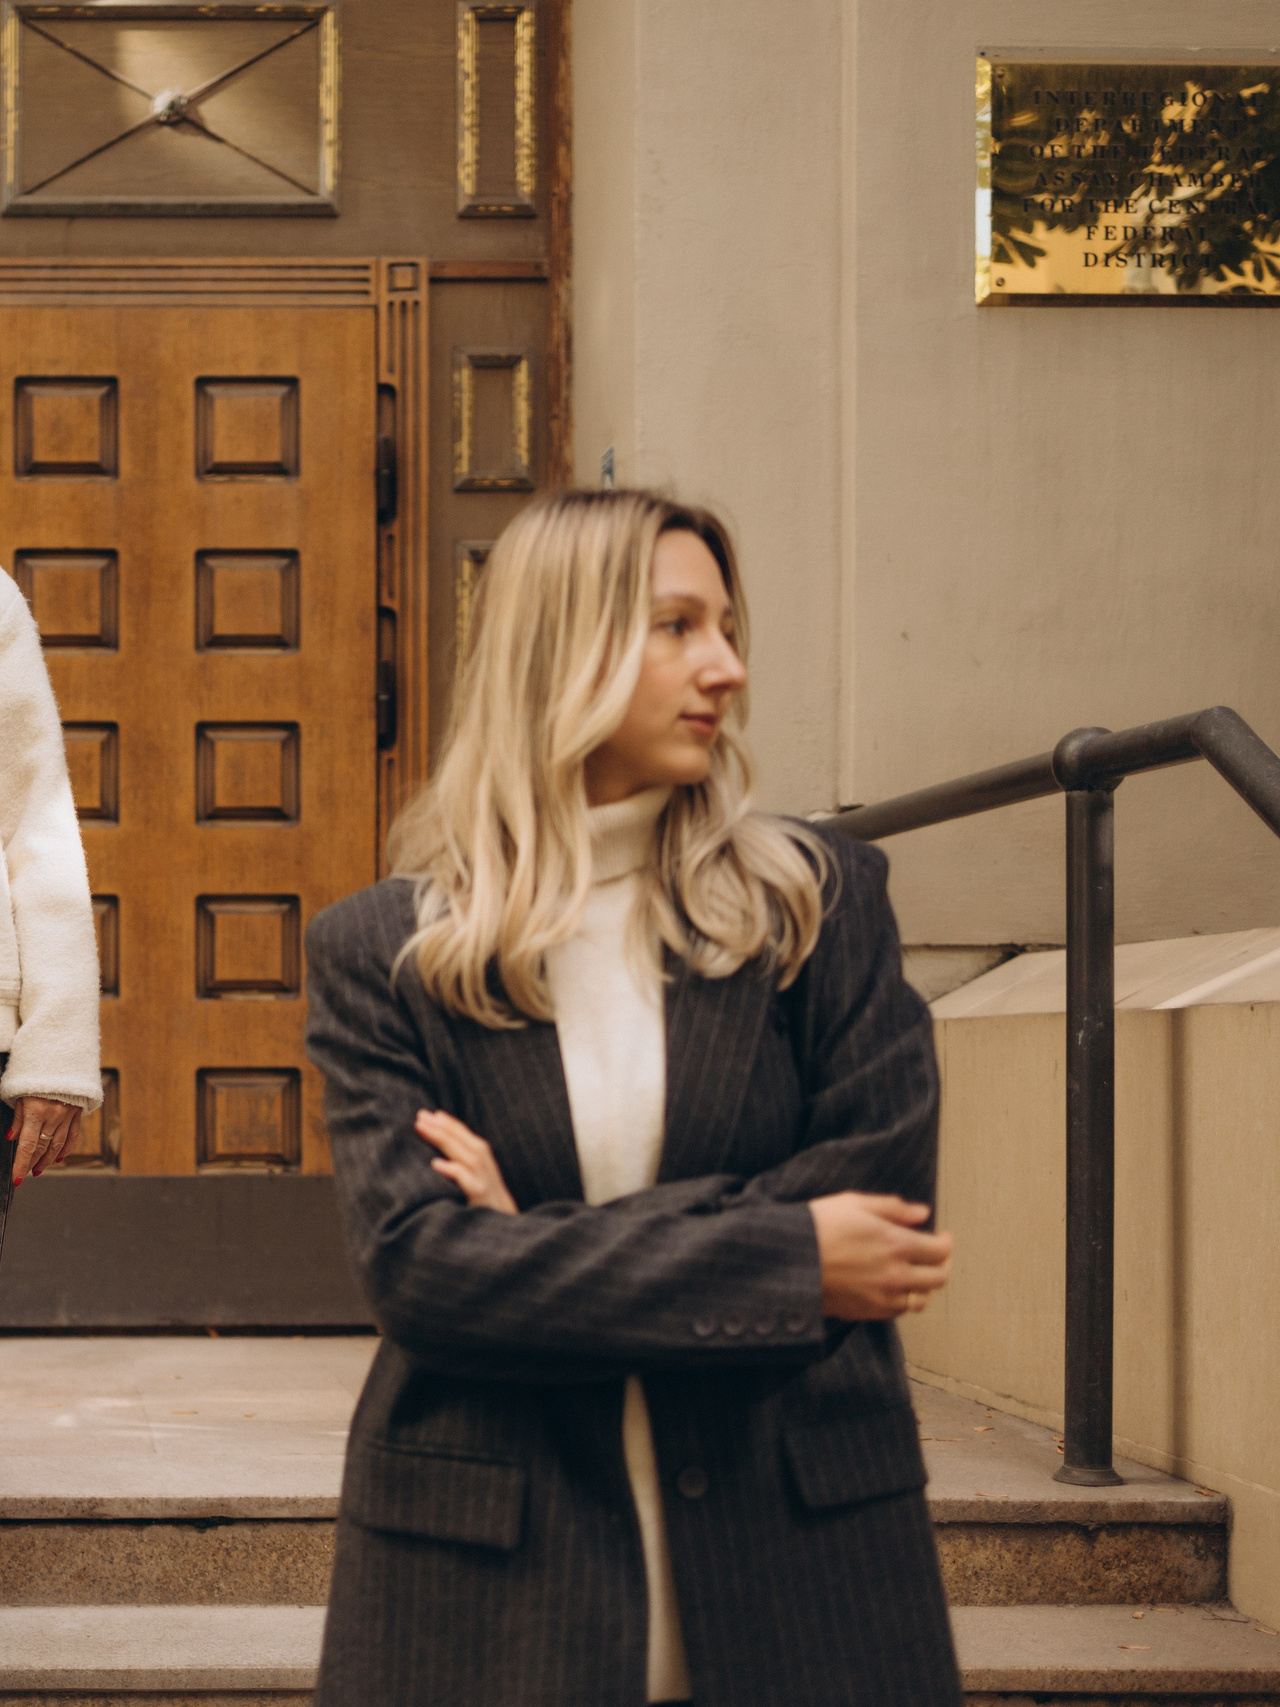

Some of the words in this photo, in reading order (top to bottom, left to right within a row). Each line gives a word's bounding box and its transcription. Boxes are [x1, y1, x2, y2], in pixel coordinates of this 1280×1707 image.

[1029, 144, 1065, 159] OF
[1075, 144, 1121, 160] THE
[1036, 172, 1117, 187] ASSAY
[1022, 198, 1074, 214] FOR
[1087, 198, 1138, 214] THE
[1085, 225, 1207, 241] FEDERAL
[1082, 252, 1216, 268] DISTRICT
